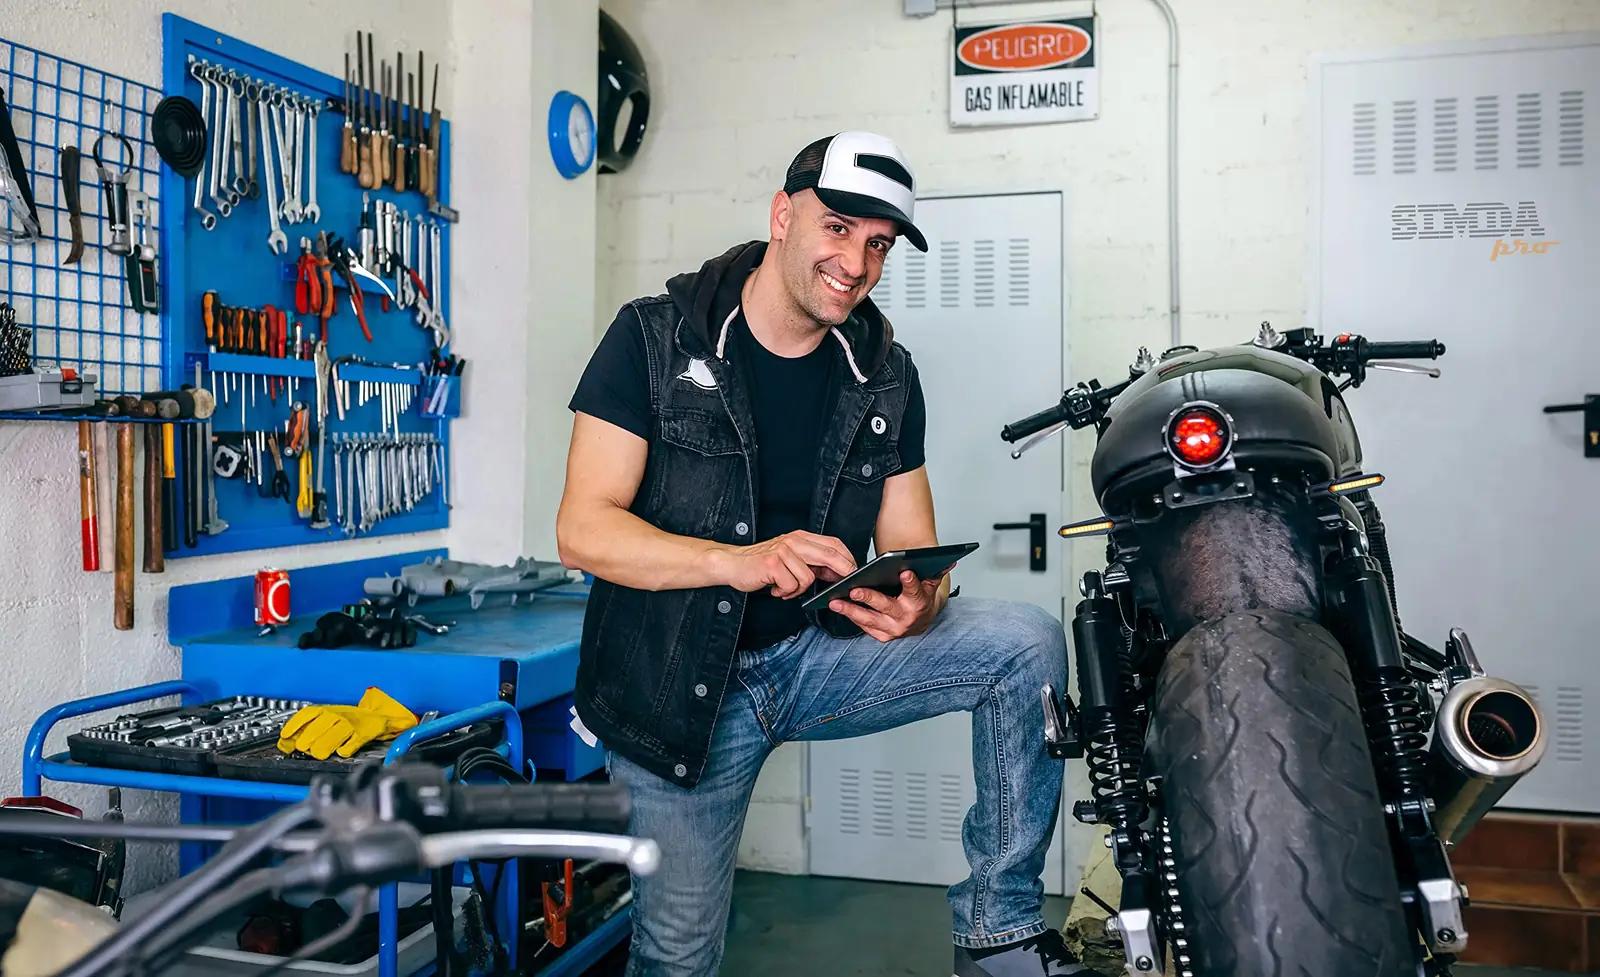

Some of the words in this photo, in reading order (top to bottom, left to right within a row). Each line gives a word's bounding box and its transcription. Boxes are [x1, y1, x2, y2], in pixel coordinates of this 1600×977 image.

[965, 86, 992, 112] GAS
[997, 80, 1084, 110] INFLAMABLE
[1391, 201, 1545, 240] SIMDA
[1490, 239, 1561, 262] pro
